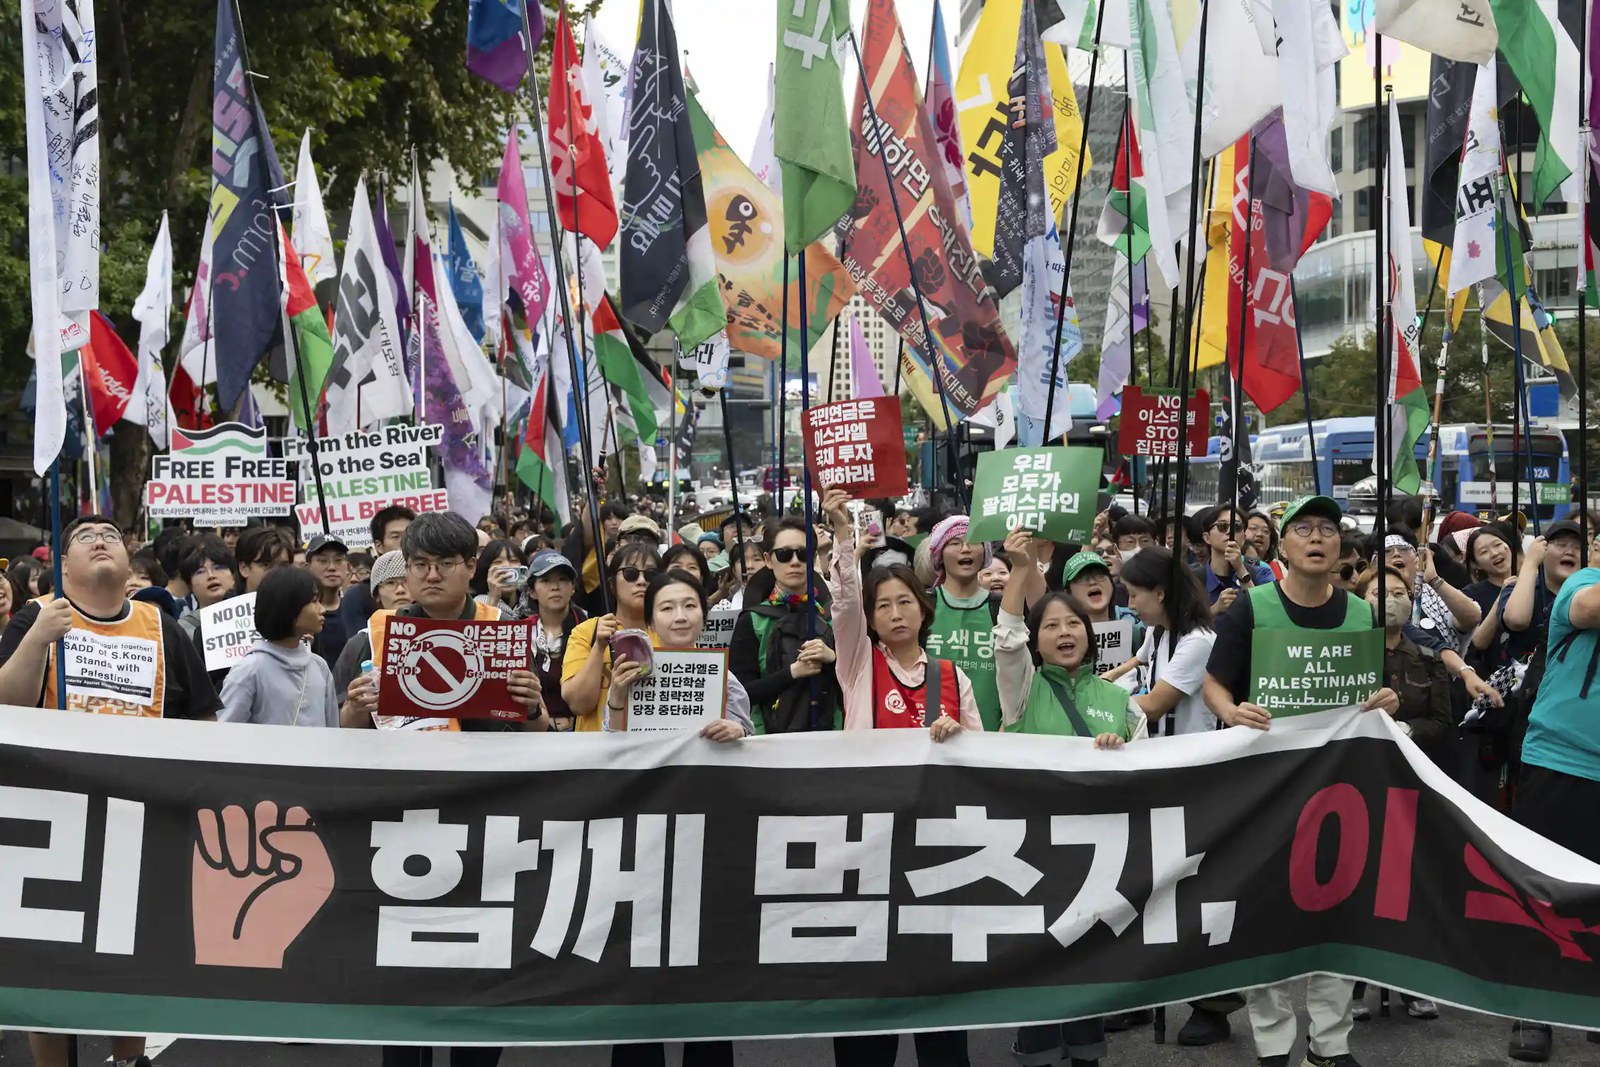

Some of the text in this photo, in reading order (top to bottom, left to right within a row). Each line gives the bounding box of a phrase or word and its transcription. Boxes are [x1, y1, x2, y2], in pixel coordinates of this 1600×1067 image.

[809, 400, 875, 427] 국민연금은
[283, 425, 443, 456] Frm the River
[814, 422, 867, 447] 이스라엘
[1145, 425, 1188, 439] STO
[338, 456, 375, 473] the
[379, 451, 420, 470] Sea
[838, 443, 873, 463] 투자
[1013, 452, 1053, 472] 우리
[154, 456, 285, 479] FREE FREE
[306, 471, 430, 501] PALESTINE
[1001, 471, 1061, 493] 모두가
[148, 482, 295, 505] PALESTINE
[982, 491, 1079, 516] 팔레스타인
[297, 506, 354, 526] WLL
[1005, 511, 1046, 532] 이다
[212, 606, 233, 625] NO
[235, 617, 250, 629] NO
[390, 621, 527, 640] NO 이스라엘
[206, 630, 246, 651] STOP
[388, 638, 527, 657] STOP 집단학살
[926, 629, 995, 659] 녹색당
[111, 650, 153, 663] S.Korea
[1287, 645, 1352, 658] WE ARE
[75, 655, 140, 673] Stands with
[490, 657, 527, 668] Israel
[1304, 661, 1336, 674] ALL
[80, 667, 133, 684] Palestine.
[465, 669, 515, 680] Genoci
[660, 677, 706, 689] 집단학살
[1258, 672, 1377, 690] PALESTINIANS
[633, 690, 705, 702] 이란 침략전쟁
[633, 704, 704, 716] 당장 중단하라
[369, 808, 708, 970] 함께
[753, 805, 1238, 966] 멈추자,
